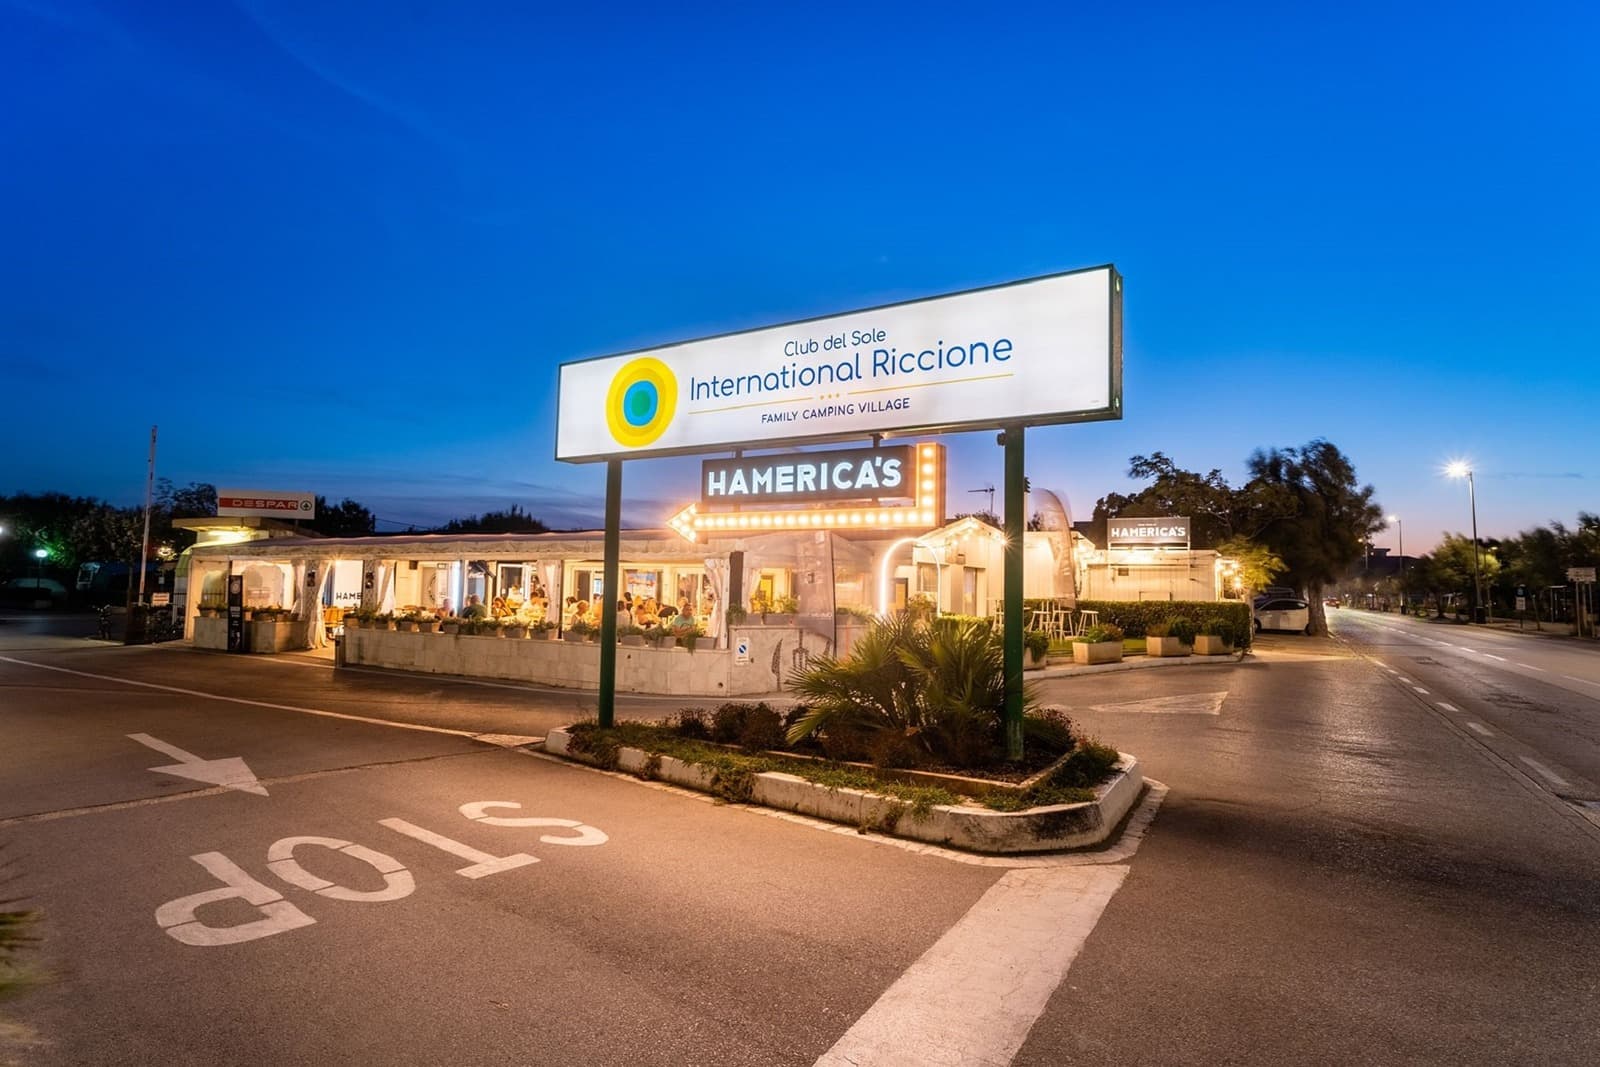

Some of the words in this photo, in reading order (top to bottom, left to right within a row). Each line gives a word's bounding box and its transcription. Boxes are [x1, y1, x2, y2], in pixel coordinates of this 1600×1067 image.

[784, 338, 819, 357] Club
[823, 333, 847, 351] del
[851, 328, 886, 346] Sole
[690, 352, 862, 401] International
[873, 338, 1013, 378] Riccione
[761, 411, 798, 424] FAMILY
[802, 403, 855, 420] CAMPING
[858, 397, 911, 413] VILLAGE
[708, 456, 902, 497] HAMERICA'S
[232, 499, 297, 509] DESPAR
[1111, 526, 1186, 537] HAMERICA'S
[154, 800, 609, 946] STOP
